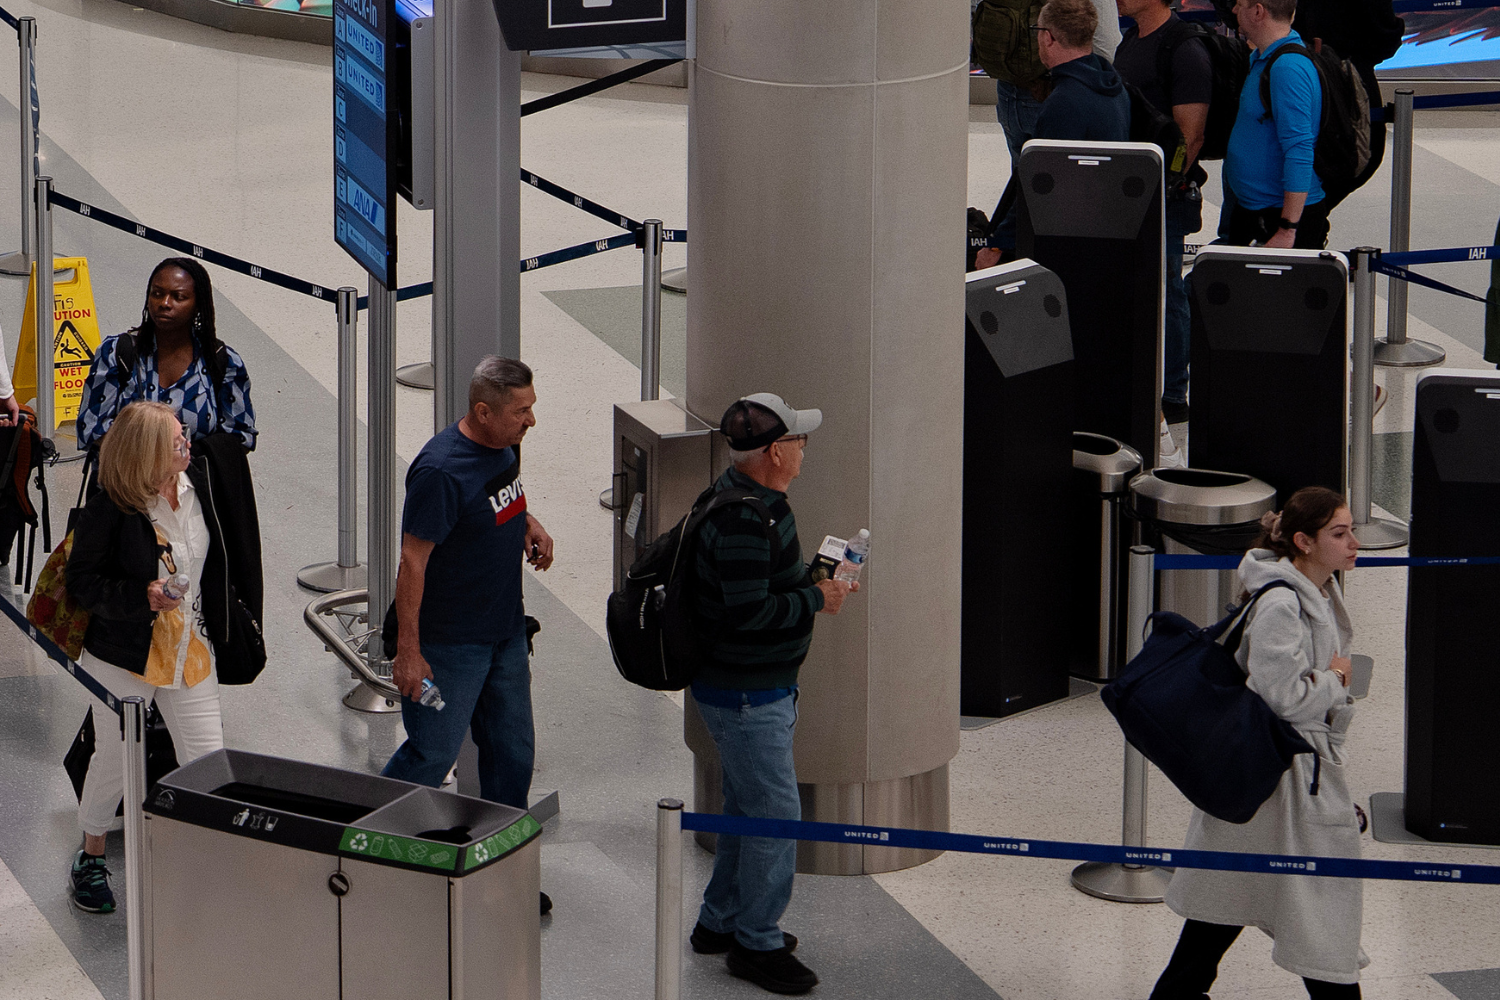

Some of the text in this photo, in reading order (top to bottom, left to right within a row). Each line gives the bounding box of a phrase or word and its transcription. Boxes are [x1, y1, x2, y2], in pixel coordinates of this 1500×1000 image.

[348, 23, 374, 54] UNITED
[348, 63, 374, 96] UNITED
[353, 188, 370, 220] ANA
[662, 231, 674, 240] AH
[971, 238, 1199, 253] IAH IAH
[80, 203, 322, 297] IAH IAH IAH IAH IAH
[526, 240, 608, 269] IAH IAH
[1469, 248, 1487, 259] IAH
[54, 309, 91, 320] UTION
[59, 367, 82, 377] WET
[54, 379, 87, 390] FLOO
[845, 831, 879, 839] UNITED
[1126, 852, 1161, 860] UNITED
[1270, 861, 1305, 869] UNITED
